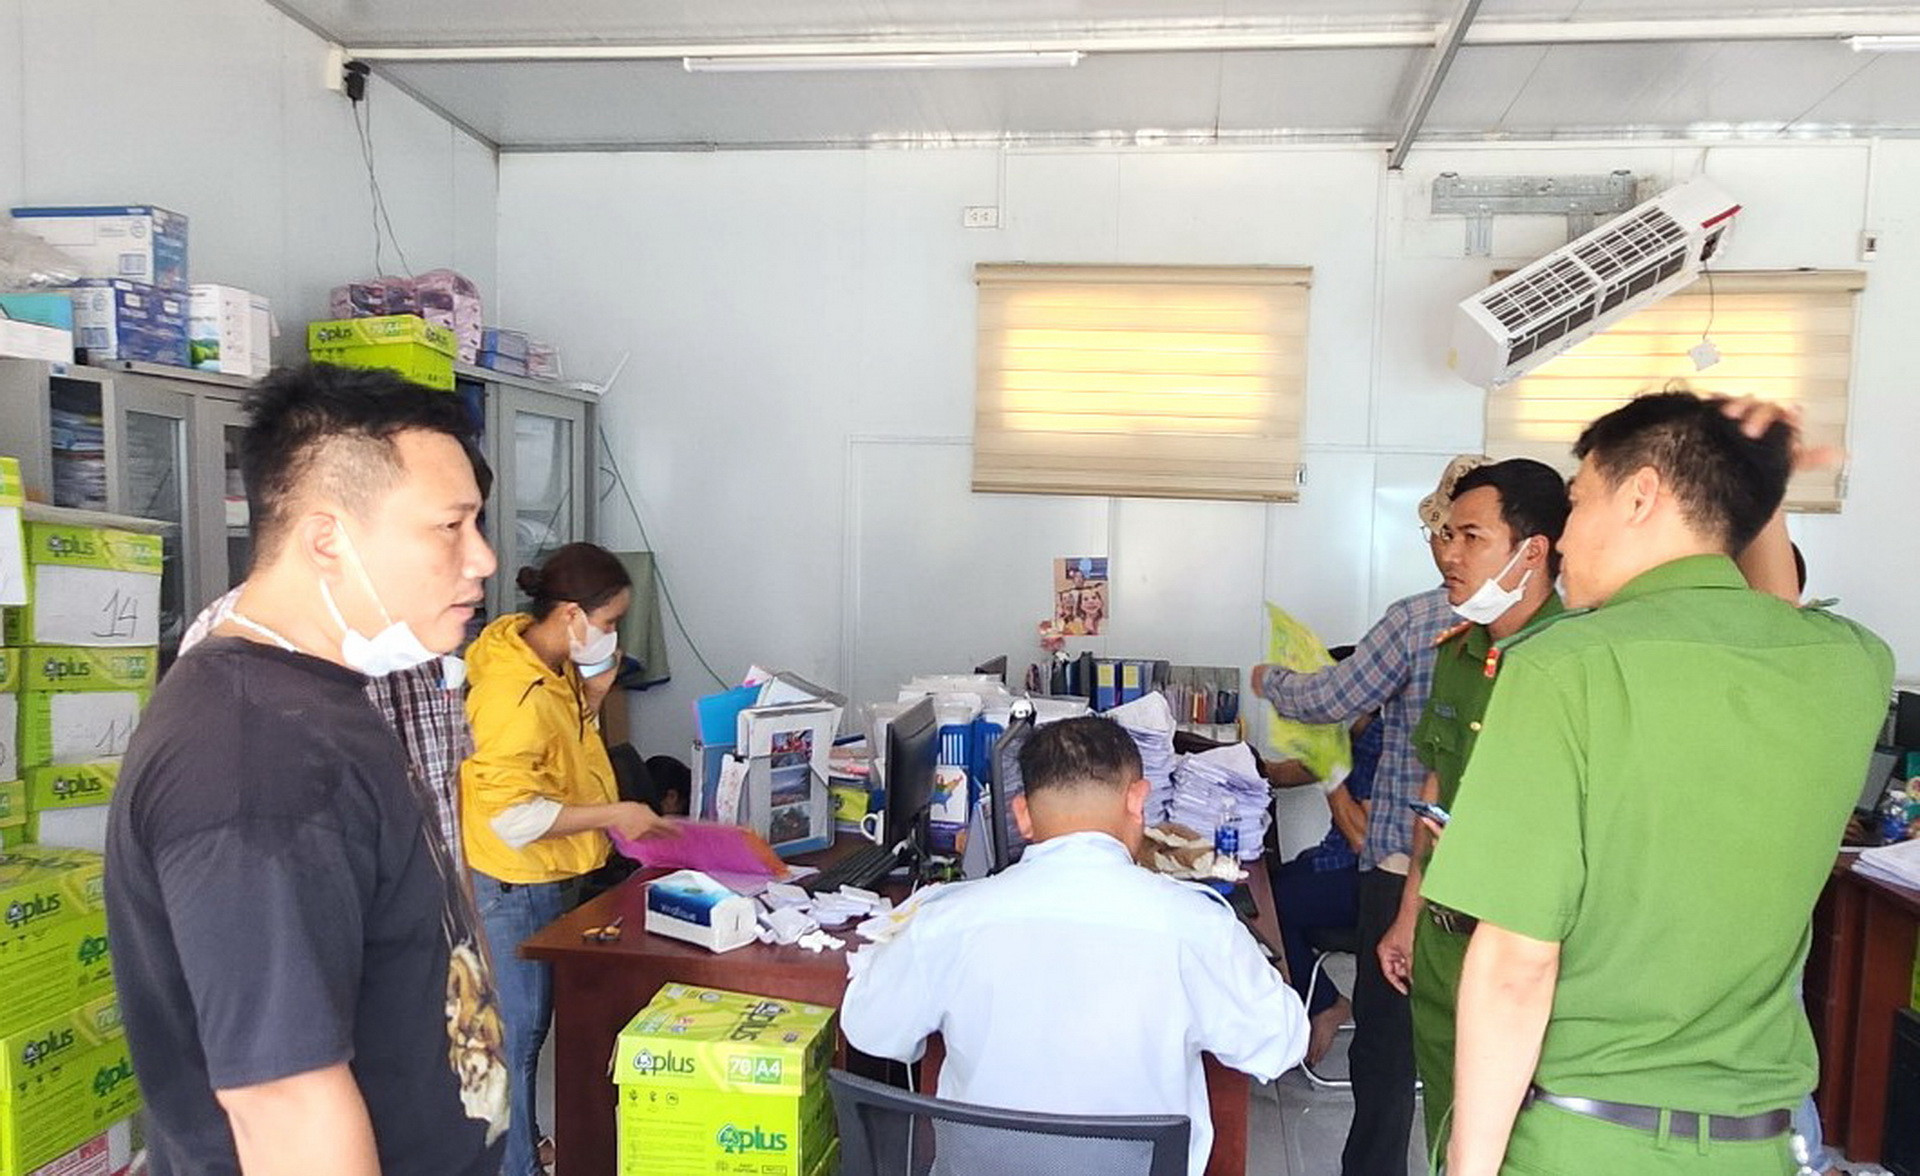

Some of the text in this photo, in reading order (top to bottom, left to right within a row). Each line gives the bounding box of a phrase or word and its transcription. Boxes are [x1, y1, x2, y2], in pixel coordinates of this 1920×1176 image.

[328, 325, 352, 340] plus
[63, 533, 94, 557] plus
[93, 588, 138, 639] 14
[59, 656, 91, 680] plus
[67, 771, 102, 798] plus
[23, 893, 61, 925] plus
[730, 1011, 781, 1041] plus
[37, 1028, 75, 1064] plus
[653, 1050, 695, 1076] plus
[755, 1058, 781, 1077] A4
[738, 1125, 788, 1154] plus
